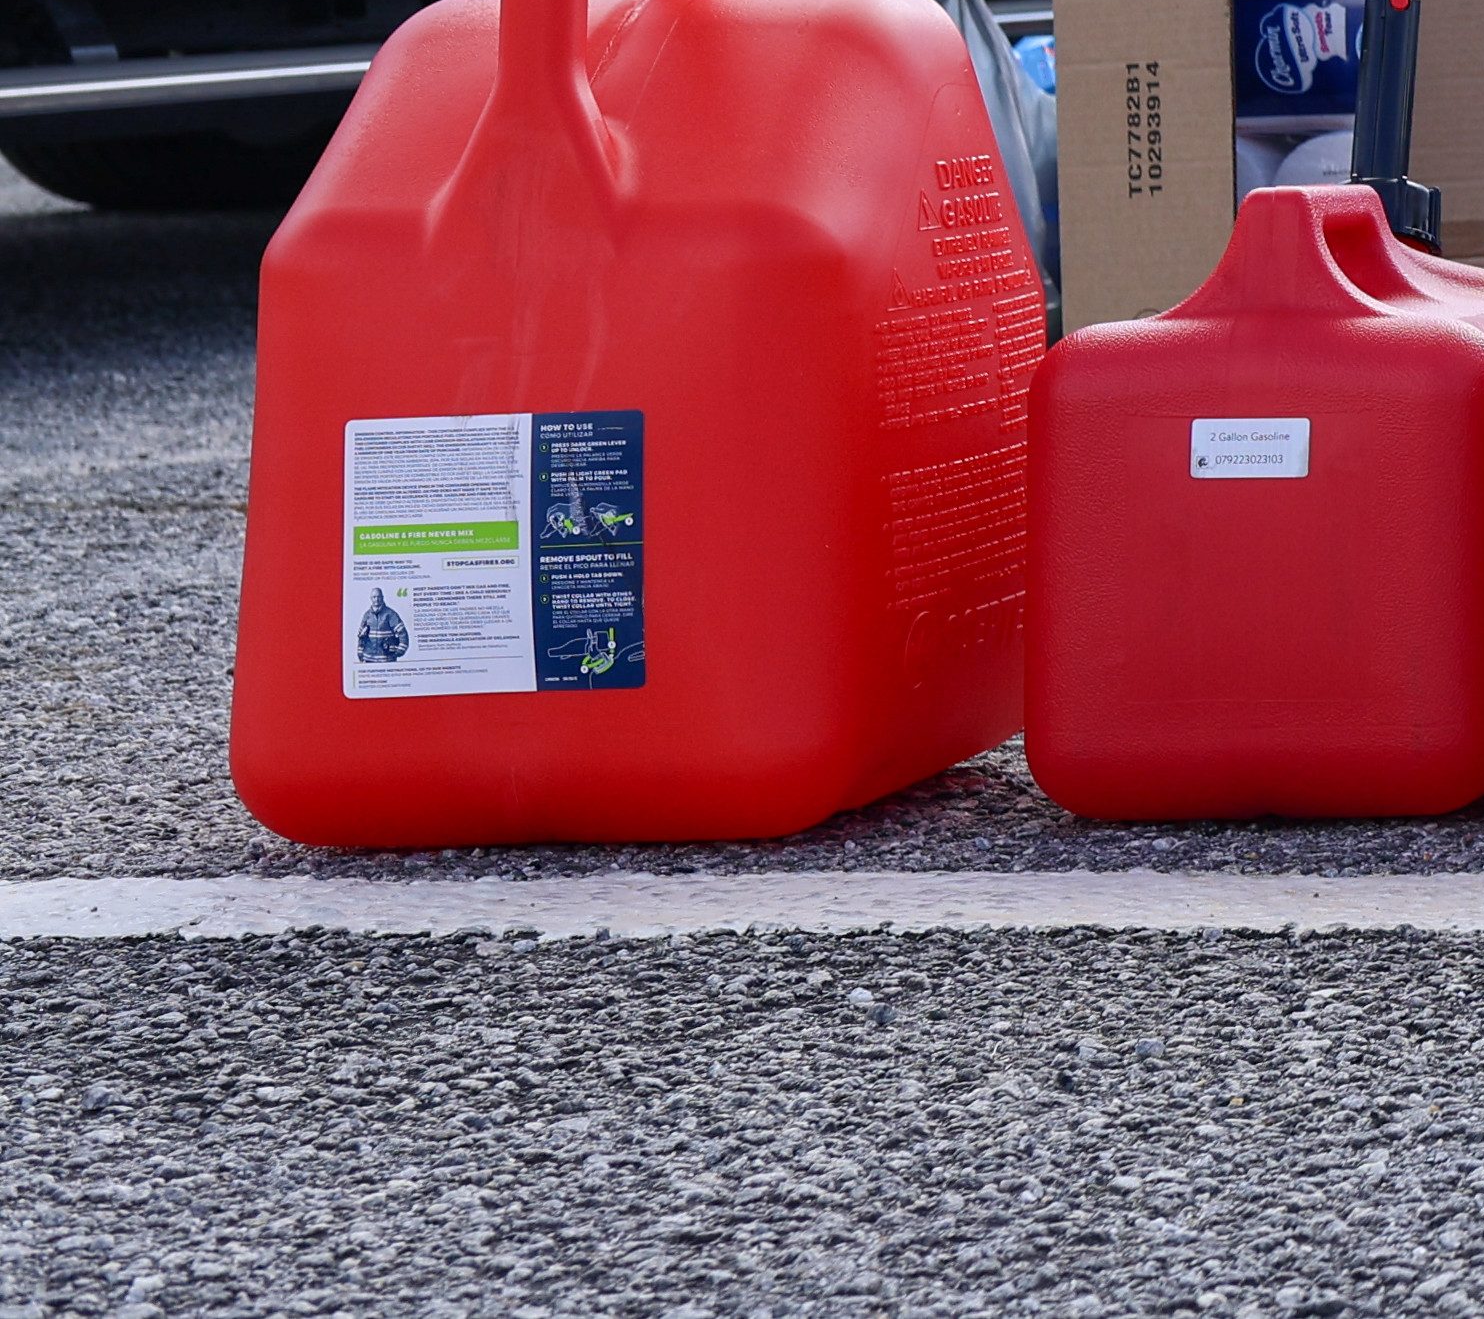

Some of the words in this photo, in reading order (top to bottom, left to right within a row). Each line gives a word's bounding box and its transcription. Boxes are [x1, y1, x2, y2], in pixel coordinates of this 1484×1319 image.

[1126, 62, 1143, 200] TC7782B1
[1146, 60, 1163, 197] 10293914
[540, 423, 562, 432] HOW
[563, 423, 575, 431] TO
[576, 422, 593, 431] USE
[1209, 432, 1217, 442] 2
[1218, 432, 1249, 442] Gallon
[1250, 431, 1290, 442] Gasoline
[1215, 454, 1284, 465] 079223023103
[359, 532, 401, 541] GASOLINE
[408, 531, 427, 539] FIRE
[428, 530, 456, 538] NEVER
[457, 529, 474, 537] MIX
[446, 558, 516, 568] STOPGASFIRES.ORG
[539, 555, 575, 563] REMOVE
[575, 554, 602, 562] SPOUT
[603, 553, 616, 561] TO
[616, 552, 633, 560] FILL
